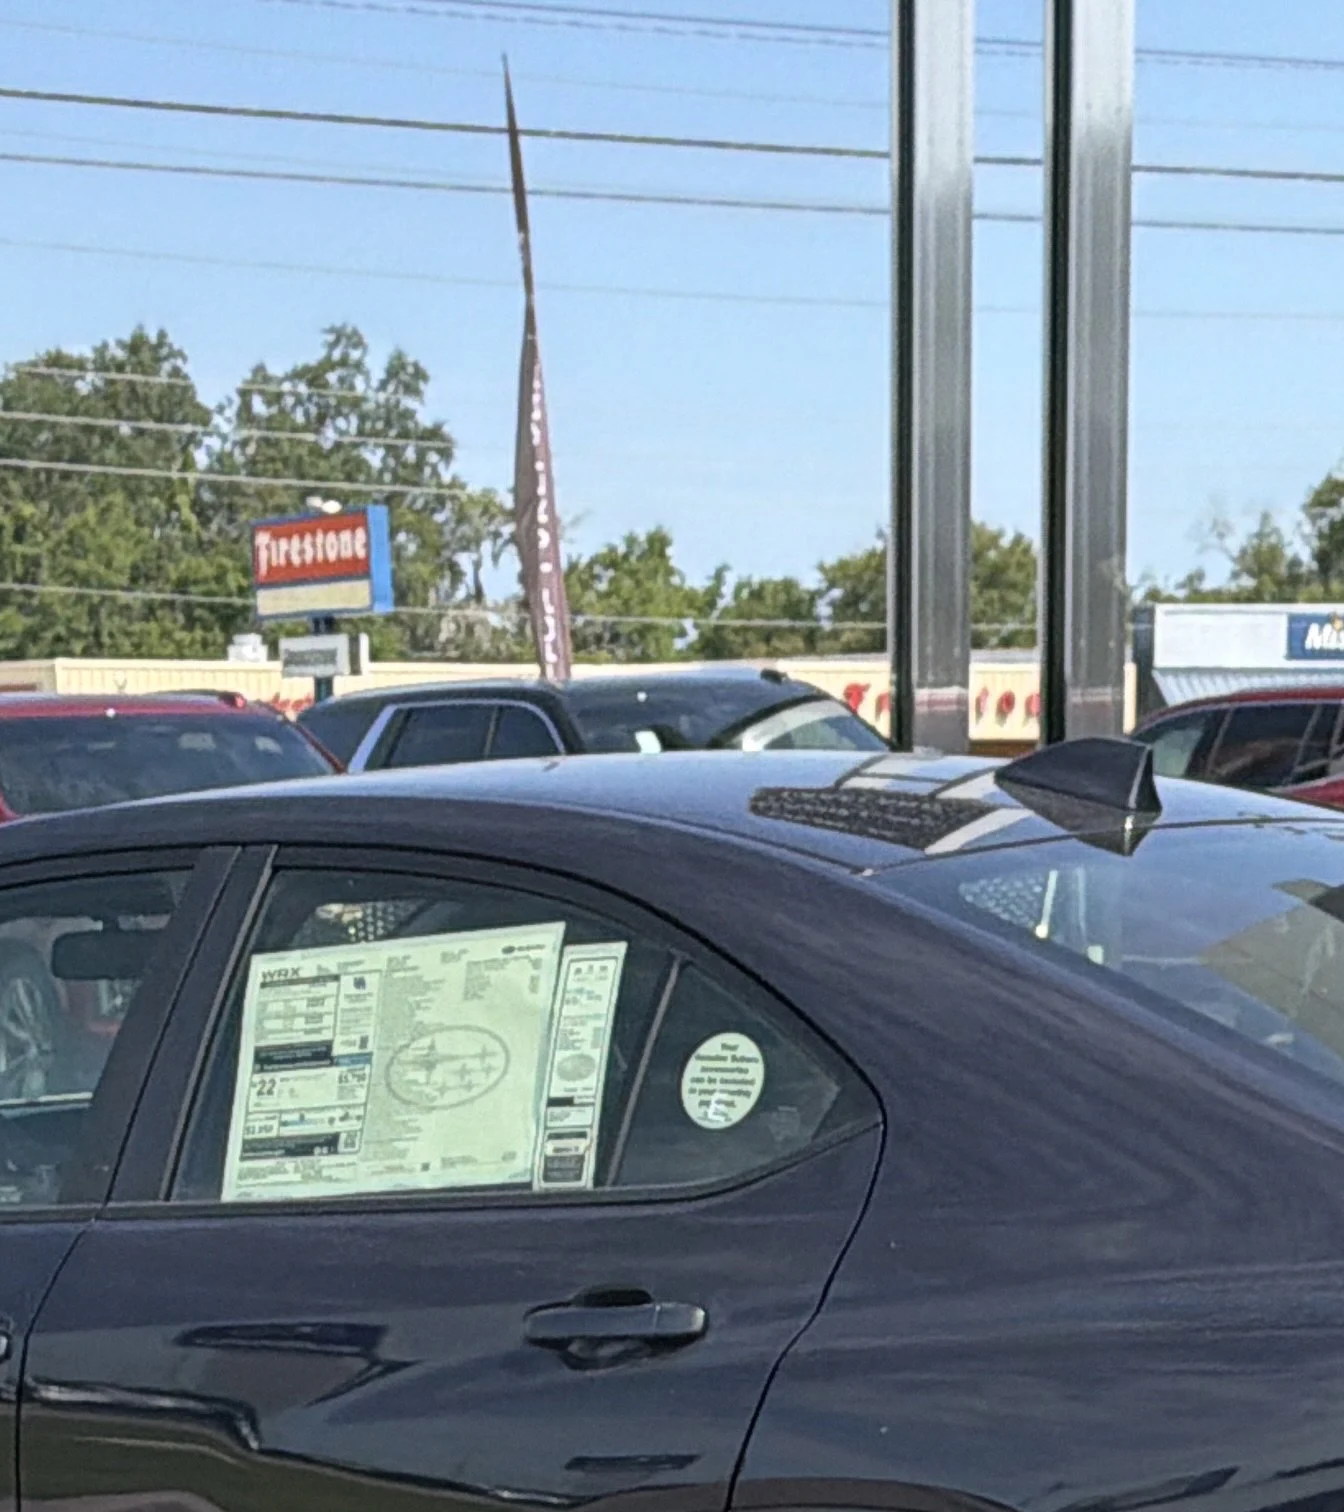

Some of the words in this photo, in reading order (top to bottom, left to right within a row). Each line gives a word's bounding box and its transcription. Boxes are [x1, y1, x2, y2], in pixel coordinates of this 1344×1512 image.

[255, 525, 368, 583] Firestone
[261, 967, 301, 979] WRX
[256, 1077, 277, 1097] 22
